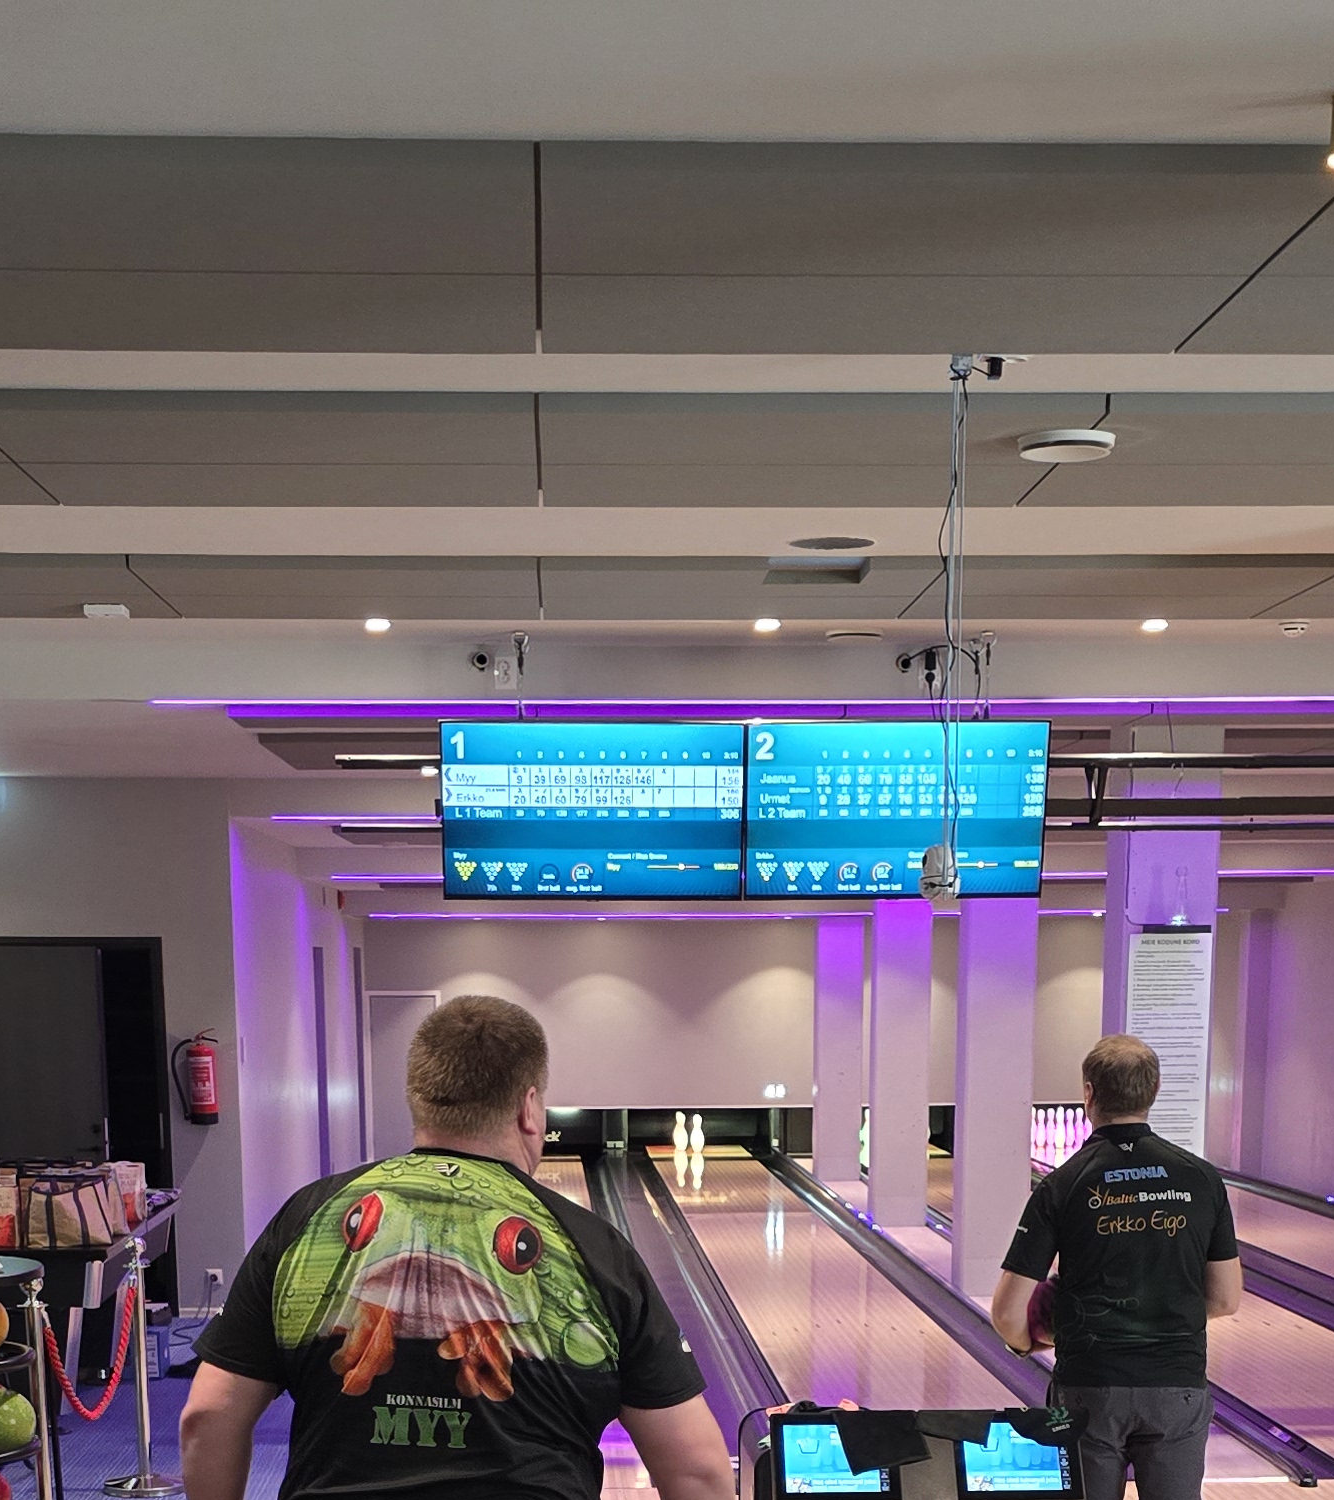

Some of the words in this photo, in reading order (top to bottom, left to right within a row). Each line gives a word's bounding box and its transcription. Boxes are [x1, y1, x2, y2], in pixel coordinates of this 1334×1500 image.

[450, 731, 465, 760] 1
[755, 731, 775, 760] 2
[455, 773, 476, 785] Myy
[593, 775, 610, 784] 117
[456, 793, 485, 803] Erkko
[455, 807, 463, 818] L
[464, 808, 471, 818] 1
[473, 807, 503, 818] Team
[758, 807, 766, 819] L
[767, 807, 776, 819] 2
[777, 807, 806, 819] Team
[1104, 1165, 1168, 1183] ESTONIA
[1096, 1215, 1146, 1235] Erkko
[1150, 1210, 1187, 1237] Eigo
[386, 1394, 462, 1409] KONNASILM
[370, 1406, 472, 1449] MYY
